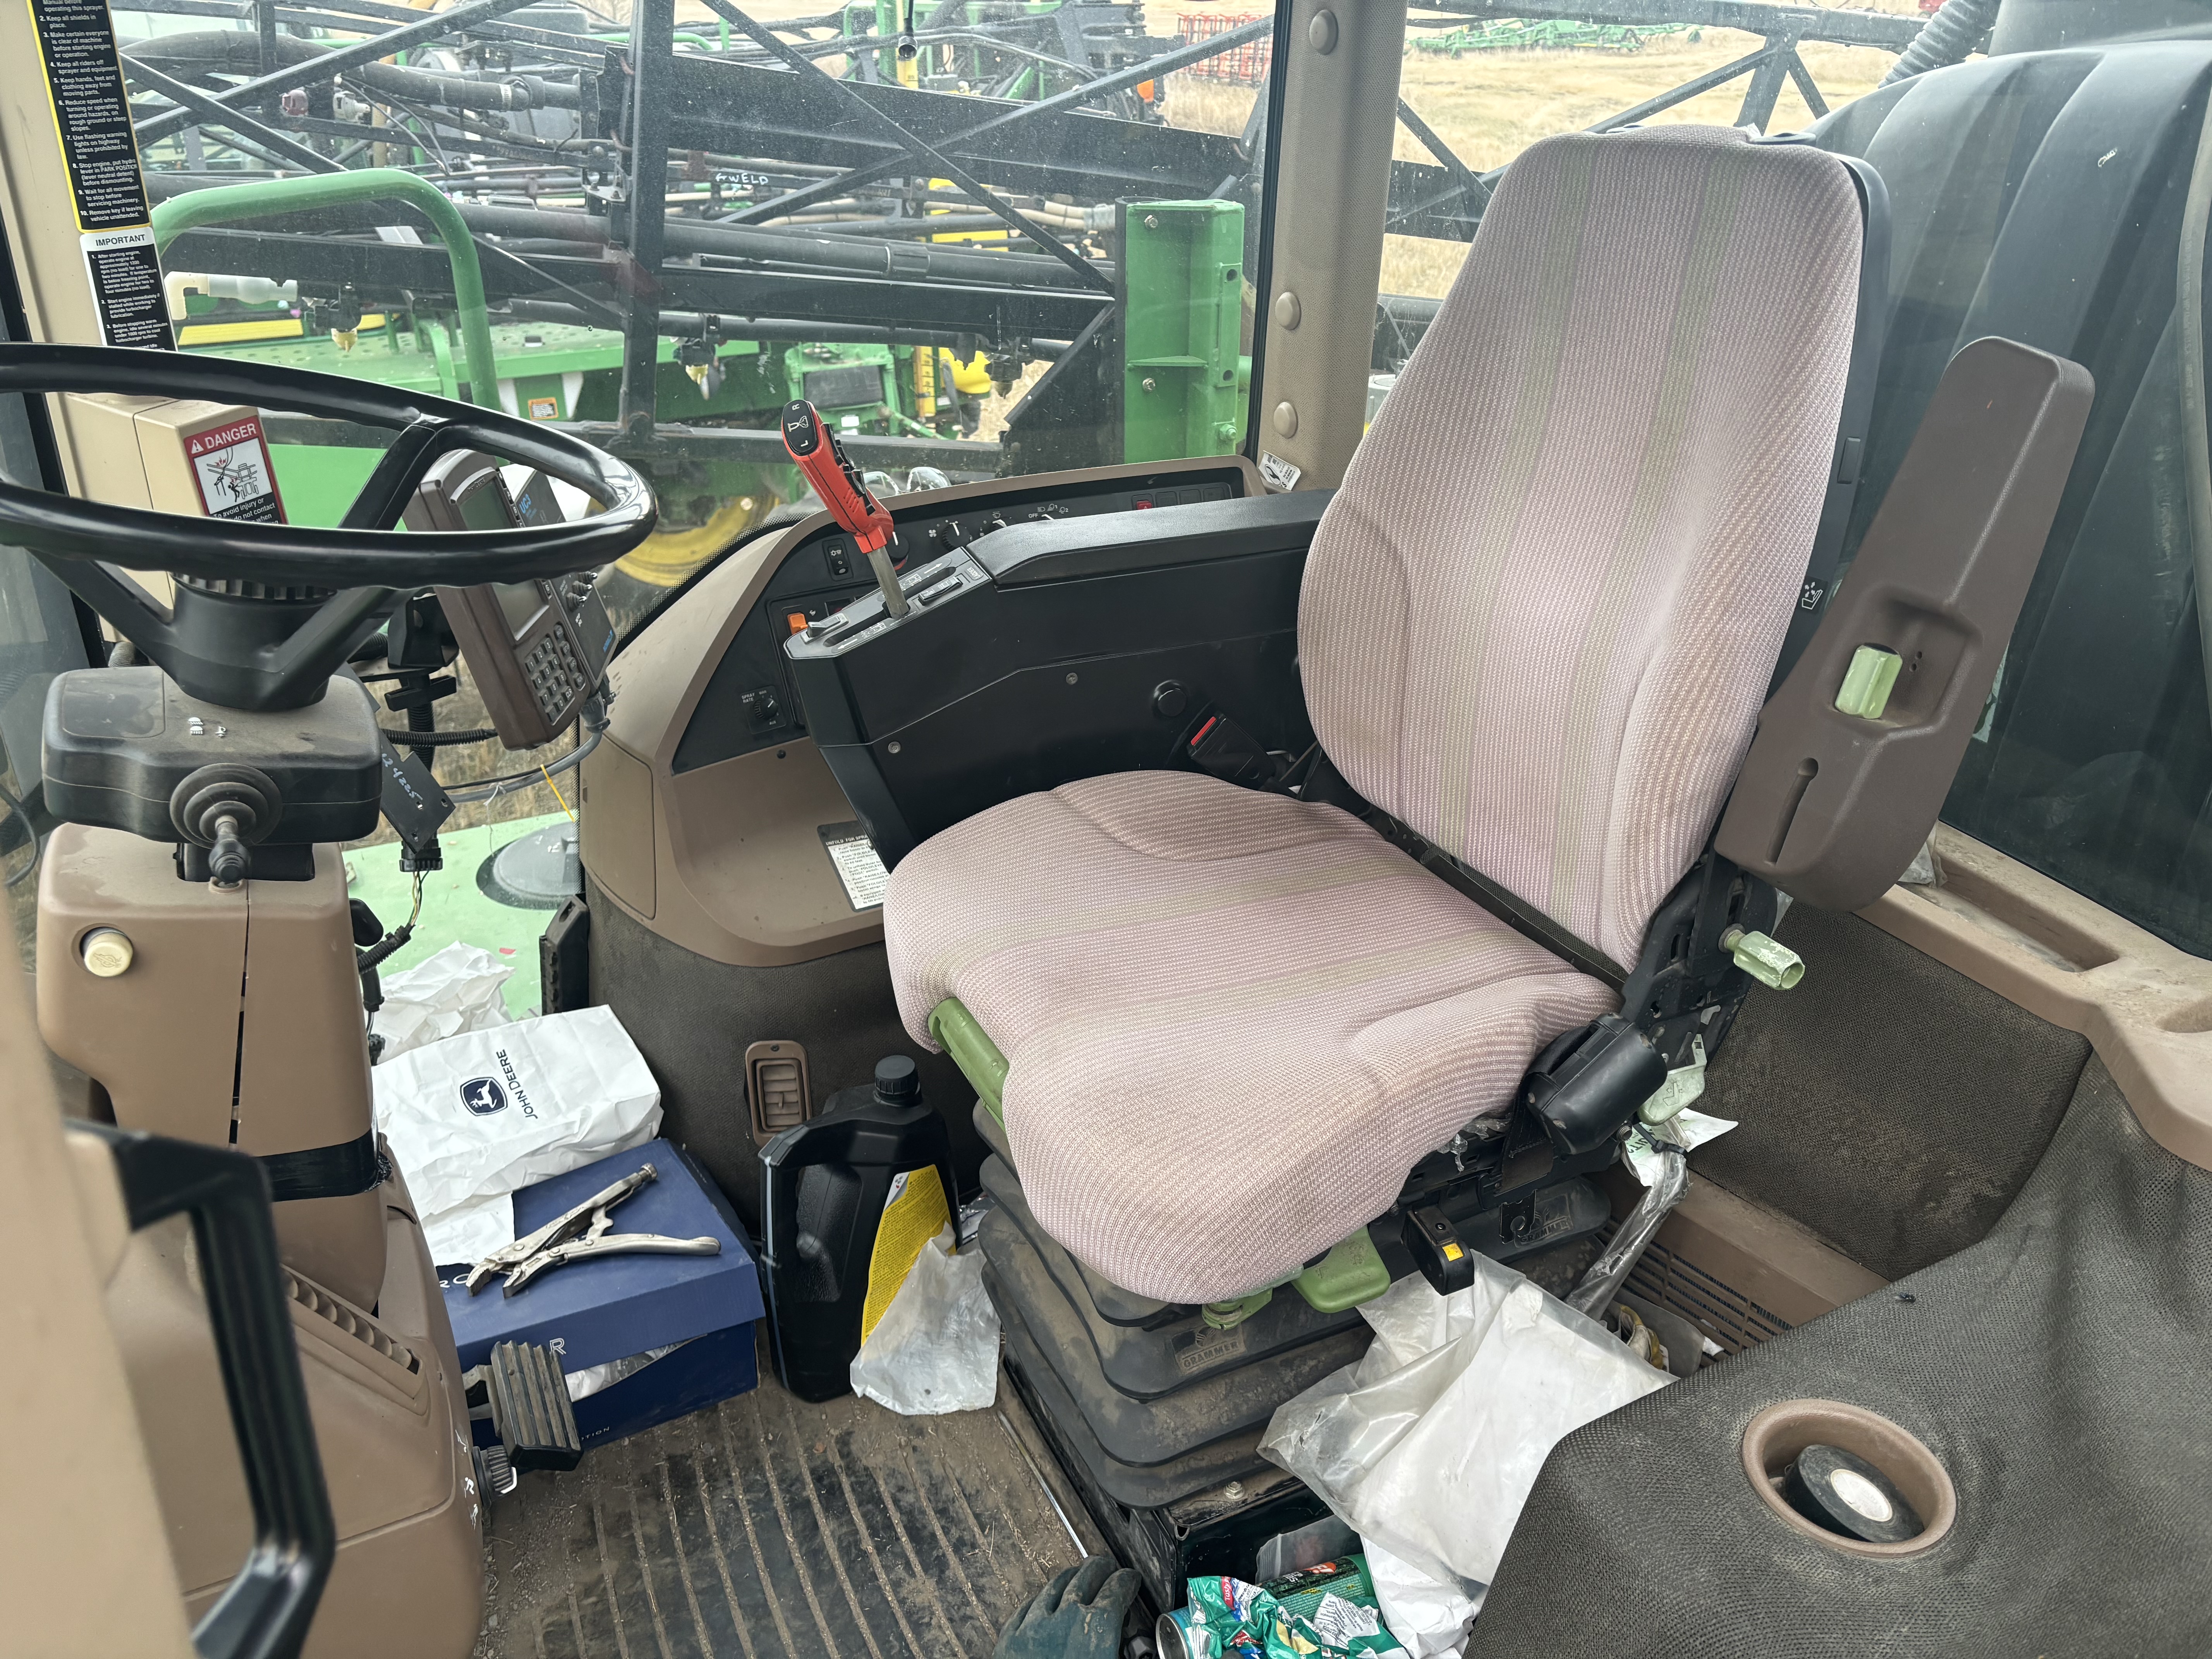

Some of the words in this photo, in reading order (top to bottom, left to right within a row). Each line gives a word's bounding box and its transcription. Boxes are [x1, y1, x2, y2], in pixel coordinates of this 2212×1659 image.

[729, 173, 769, 185] WELD
[96, 234, 145, 246] IMPORTANT
[204, 423, 257, 449] DANGER
[223, 505, 239, 517] avoid
[240, 500, 256, 510] injury
[243, 510, 252, 519] not
[253, 502, 275, 515] contact
[519, 494, 531, 514] UC3
[967, 567, 981, 579] LADDER
[496, 1049, 522, 1091] DEERE
[515, 1089, 538, 1119] JOHN
[1183, 1341, 1238, 1368] GRAMMER
